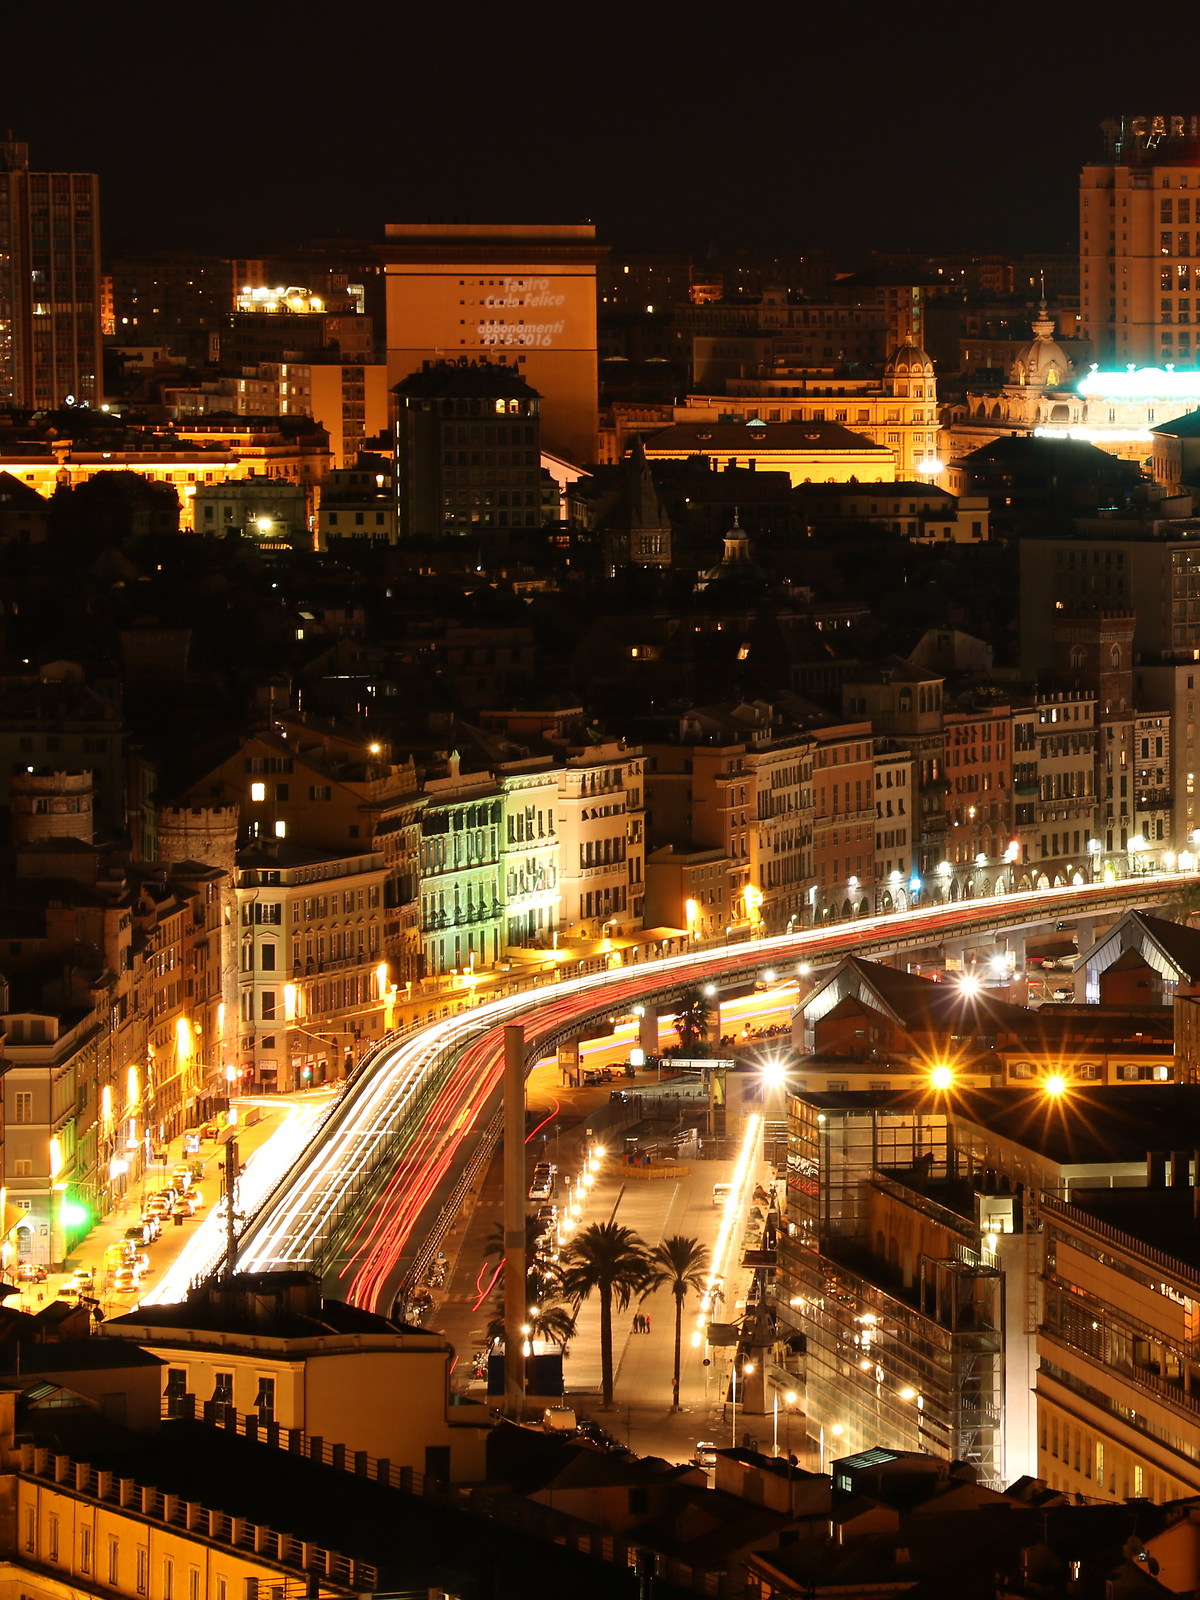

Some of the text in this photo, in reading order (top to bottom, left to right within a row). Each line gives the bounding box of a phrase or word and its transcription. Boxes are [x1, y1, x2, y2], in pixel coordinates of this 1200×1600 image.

[503, 277, 550, 293] Teatro
[485, 291, 565, 309] Carlo Felice
[477, 320, 565, 335] abbonamenti
[482, 334, 553, 346] 2015-2016
